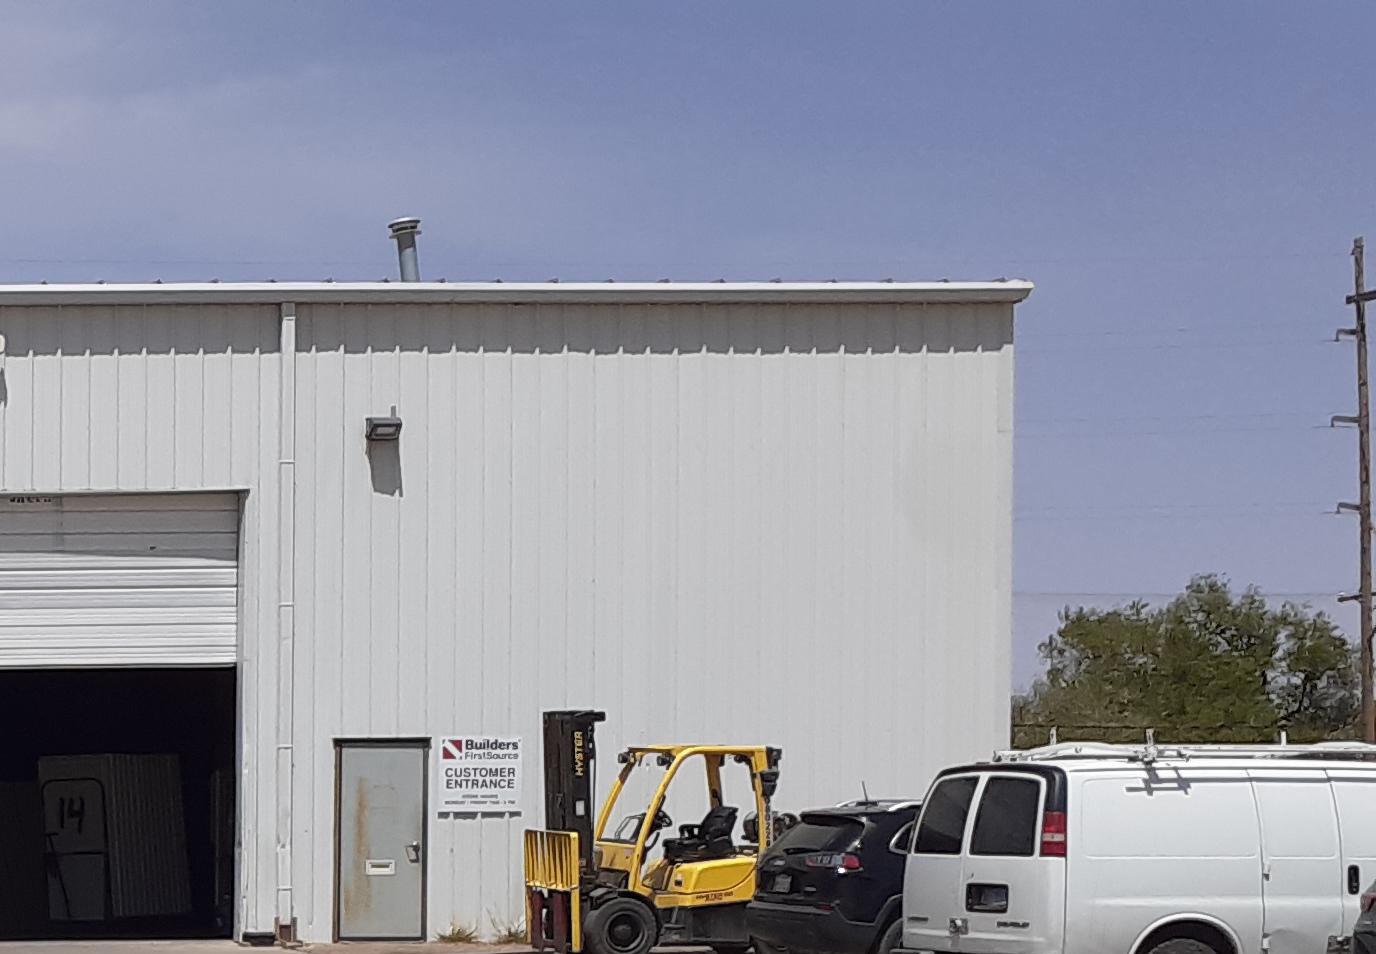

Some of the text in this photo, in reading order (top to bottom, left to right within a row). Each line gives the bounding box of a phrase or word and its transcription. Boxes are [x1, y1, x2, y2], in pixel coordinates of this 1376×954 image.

[465, 739, 519, 750] Builders
[464, 751, 519, 760] FirstSource
[574, 731, 584, 776] HYSTER
[444, 767, 516, 778] CUSTOMER
[445, 778, 515, 789] ENTRANCE
[59, 796, 85, 834] 14
